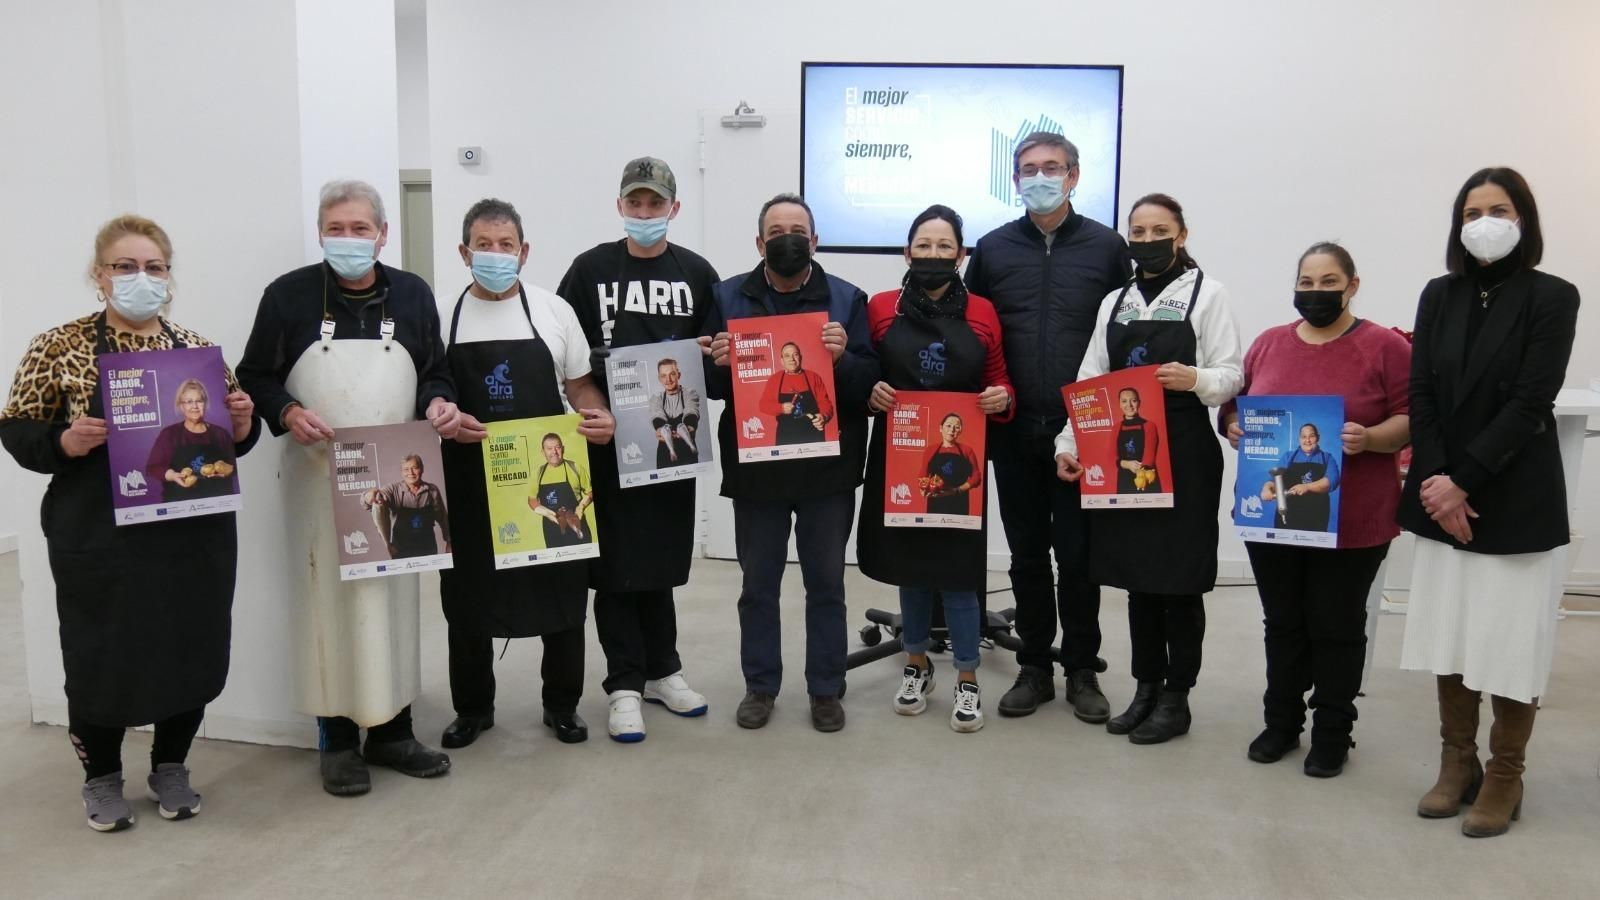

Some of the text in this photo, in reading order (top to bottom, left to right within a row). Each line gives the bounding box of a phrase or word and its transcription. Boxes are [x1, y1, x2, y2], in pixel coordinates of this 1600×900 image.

[846, 86, 909, 107] El mejor
[845, 139, 912, 161] siempre,
[598, 280, 694, 321] HARD
[734, 332, 740, 341] El
[735, 338, 770, 349] SERVICIO,
[736, 348, 754, 356] como
[618, 359, 638, 369] mejor
[108, 367, 145, 379] El mejor
[738, 368, 772, 379] MERCADO
[110, 378, 144, 390] SABOR,
[614, 381, 643, 391] siempre,
[111, 388, 134, 398] como
[112, 395, 150, 406] siempre,
[112, 405, 133, 415] en el
[1243, 408, 1255, 417] Los
[113, 411, 157, 425] MERCADO
[893, 410, 920, 421] SABOR,
[1077, 418, 1111, 429] MERCADO
[1244, 416, 1282, 427] CHURROS,
[1244, 424, 1264, 432] como
[333, 440, 365, 451] El mejor
[489, 442, 517, 452] SABOR,
[892, 437, 926, 447] MERCADO
[335, 450, 365, 460] SABOR,
[490, 451, 509, 459] como
[1244, 445, 1279, 456] MERCADO
[335, 459, 356, 468] como
[491, 457, 522, 467] siempre,
[337, 465, 371, 475] siempre,
[337, 473, 355, 483] en el
[492, 471, 528, 482] MERCADO
[337, 480, 376, 491] MERCADO
